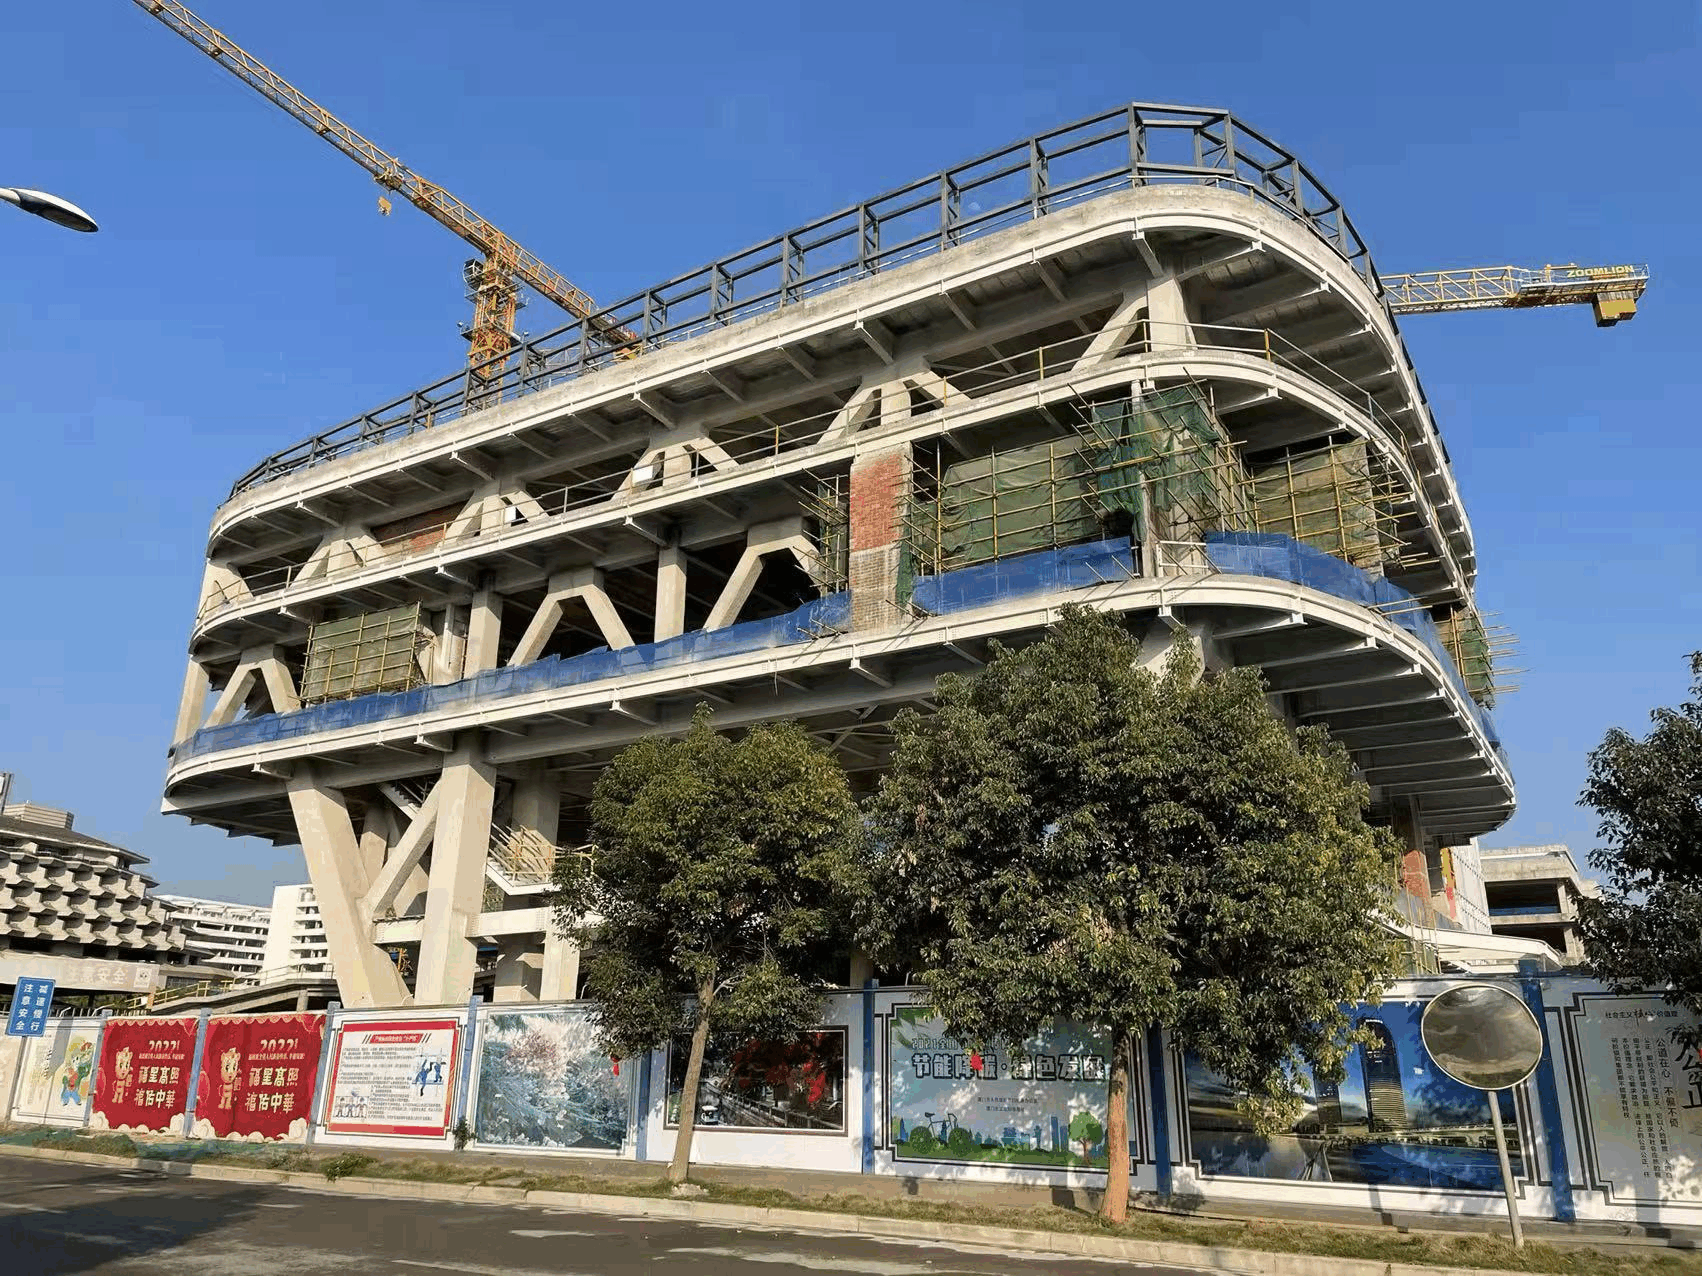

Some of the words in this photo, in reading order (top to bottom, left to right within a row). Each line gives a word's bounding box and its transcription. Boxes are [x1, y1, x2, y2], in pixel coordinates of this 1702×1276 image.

[1567, 265, 1634, 278] ZOOMLION
[15, 983, 33, 1030] 注意安全
[30, 984, 48, 1031] 减速慢行
[1656, 1038, 1671, 1078] 公道在心
